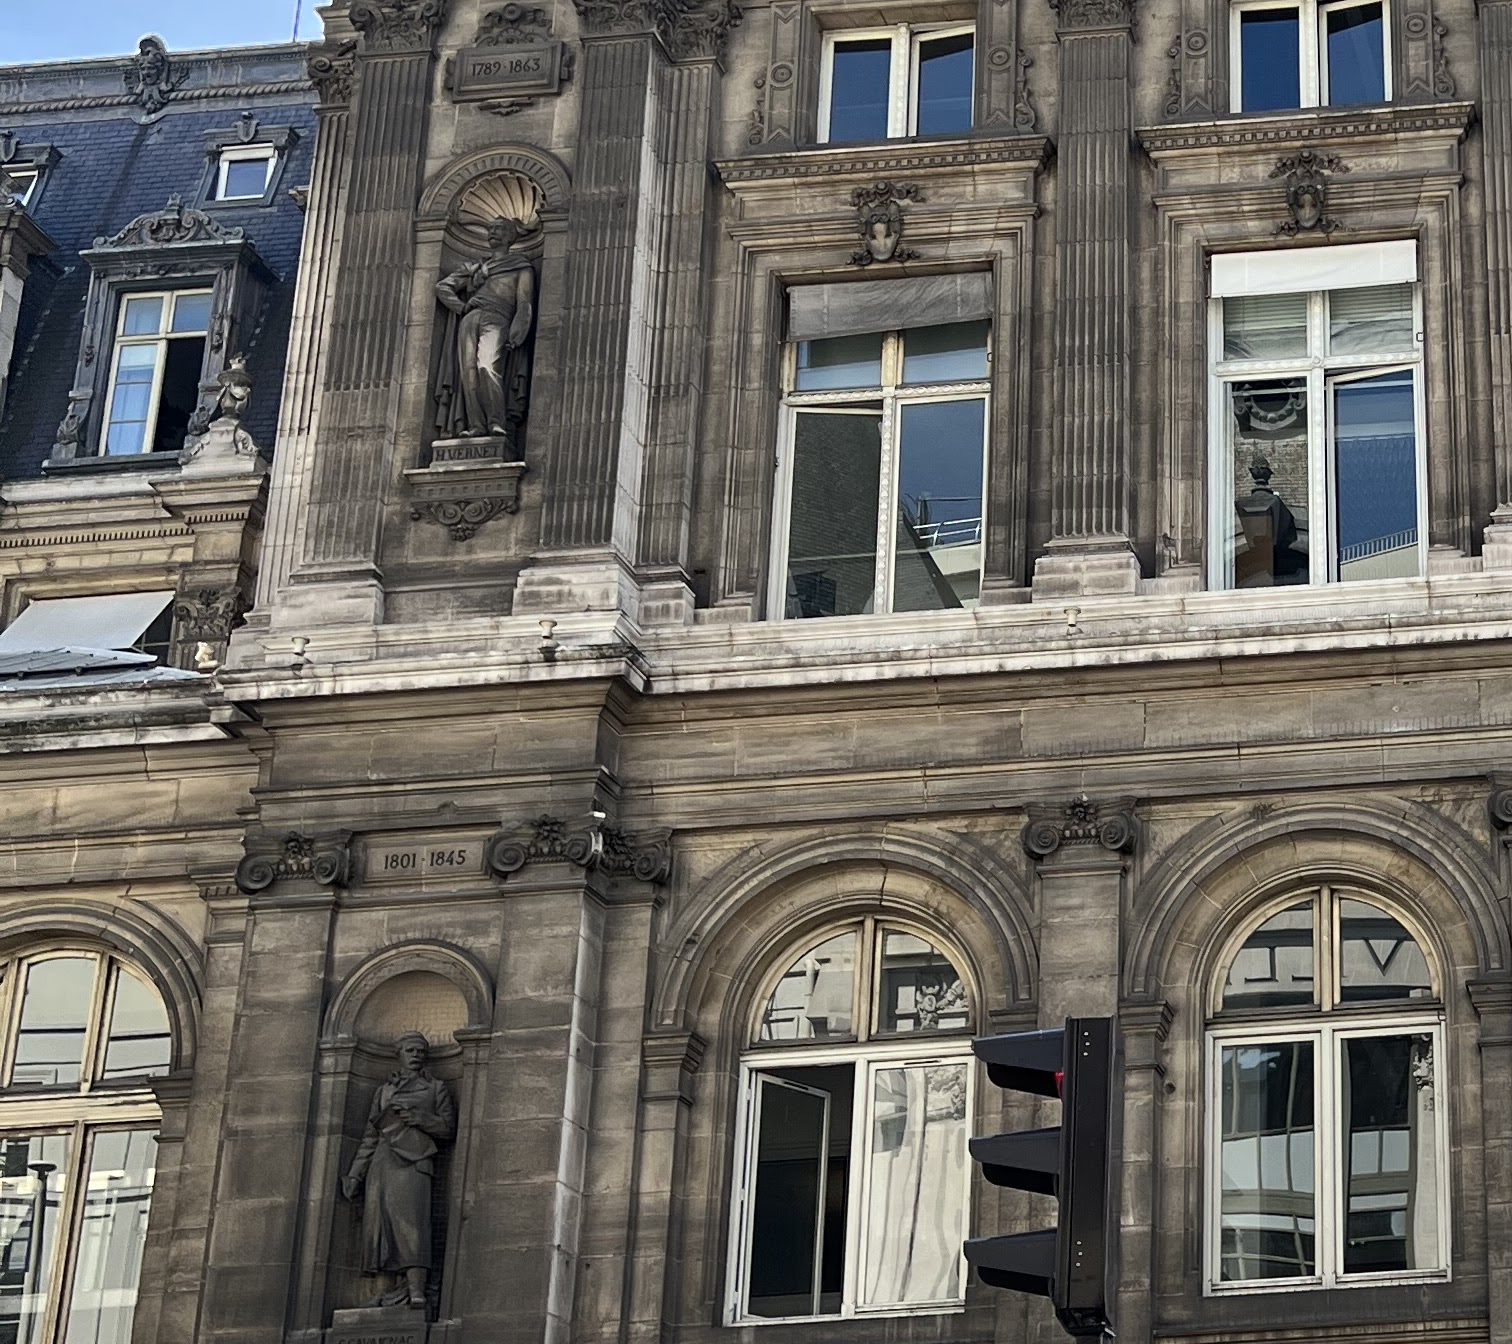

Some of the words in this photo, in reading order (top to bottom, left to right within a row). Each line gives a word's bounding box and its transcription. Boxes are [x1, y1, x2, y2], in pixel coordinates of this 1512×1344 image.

[472, 60, 502, 77] 1789
[509, 58, 541, 74] 1863
[384, 852, 417, 870] 1801
[430, 849, 467, 867] 1845
